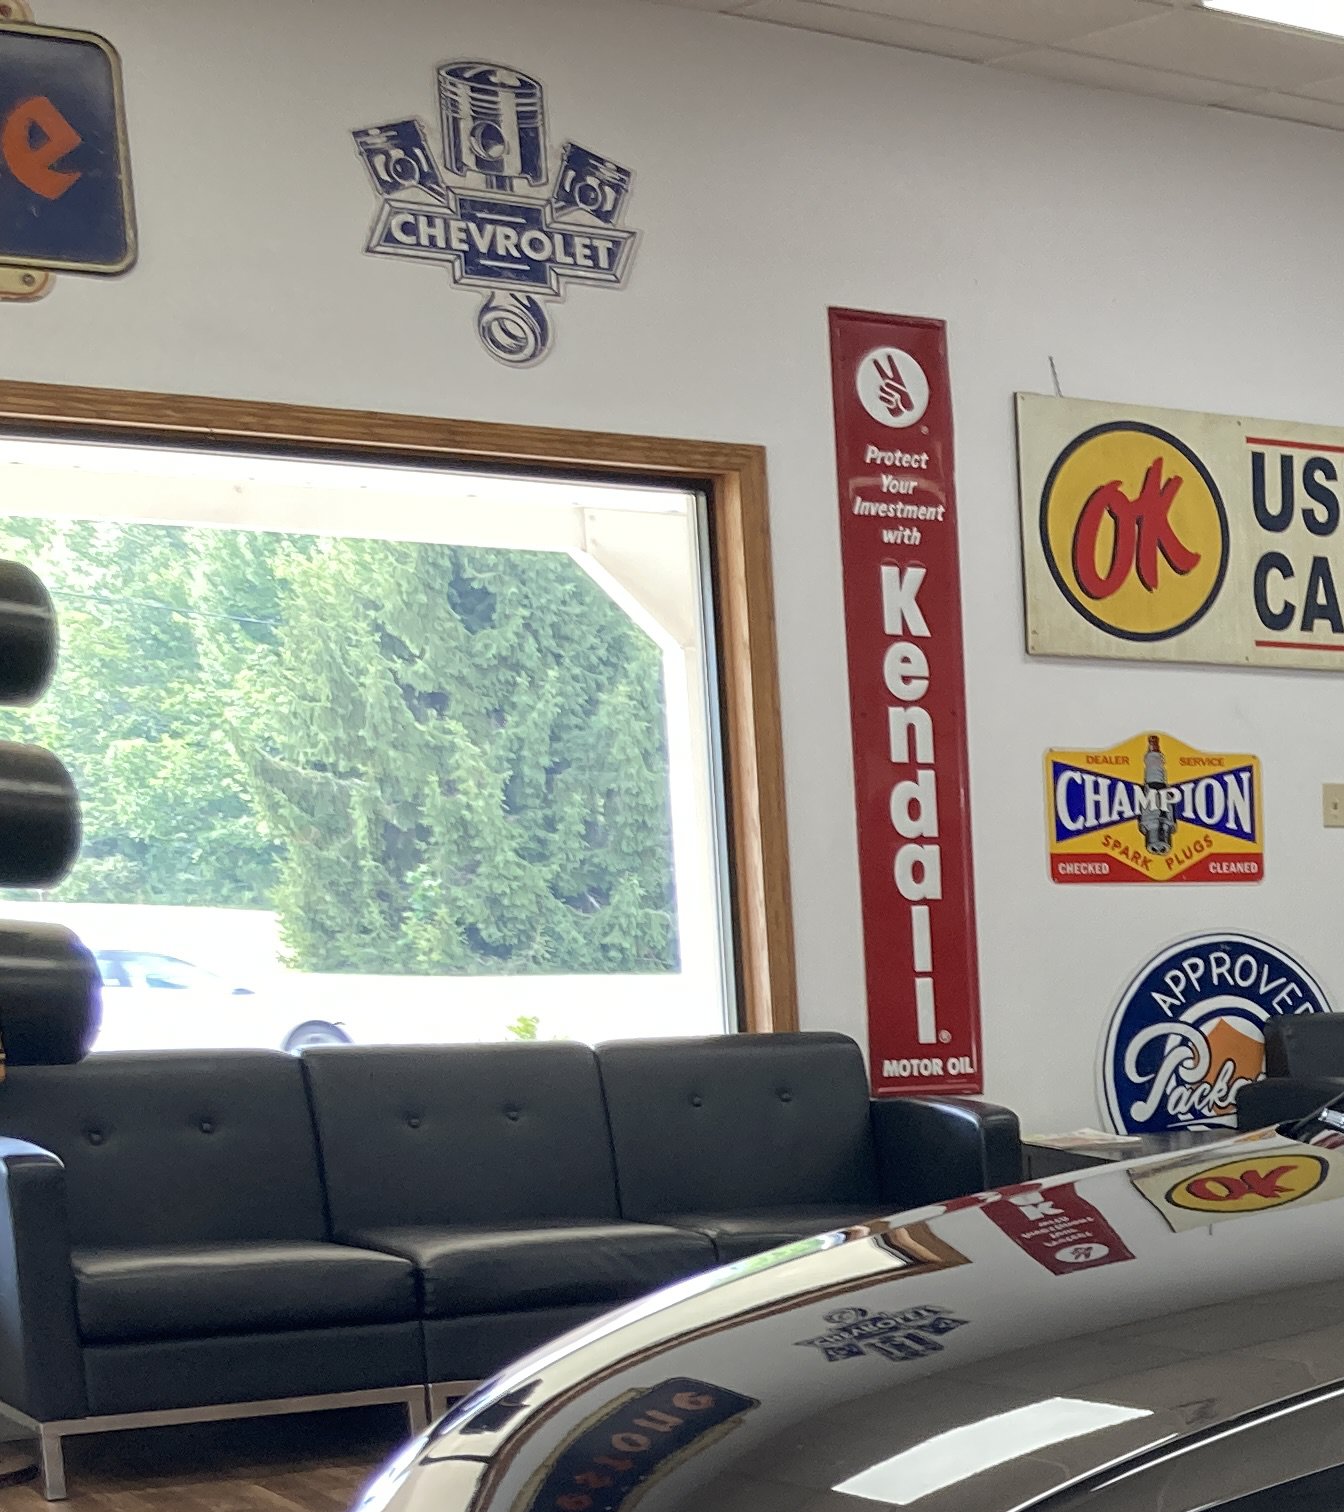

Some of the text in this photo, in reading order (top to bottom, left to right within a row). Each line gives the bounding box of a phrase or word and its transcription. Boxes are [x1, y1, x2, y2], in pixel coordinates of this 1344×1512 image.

[391, 213, 613, 269] CHEVROLET
[865, 444, 929, 469] Protect
[881, 473, 918, 494] Your
[853, 496, 945, 521] Investment
[882, 525, 921, 545] with
[1072, 457, 1201, 600] OK
[1086, 755, 1225, 767] DEALER SERVICE
[880, 566, 943, 1044] Kendall
[1056, 770, 1252, 834] CHAMPION
[1102, 834, 1215, 872] SPARK PLUGS
[1058, 862, 1110, 875] CHECKED
[1208, 861, 1259, 874] CLEANED
[882, 1056, 975, 1078] MOTOR OIL
[1124, 1022, 1266, 1122] Pack
